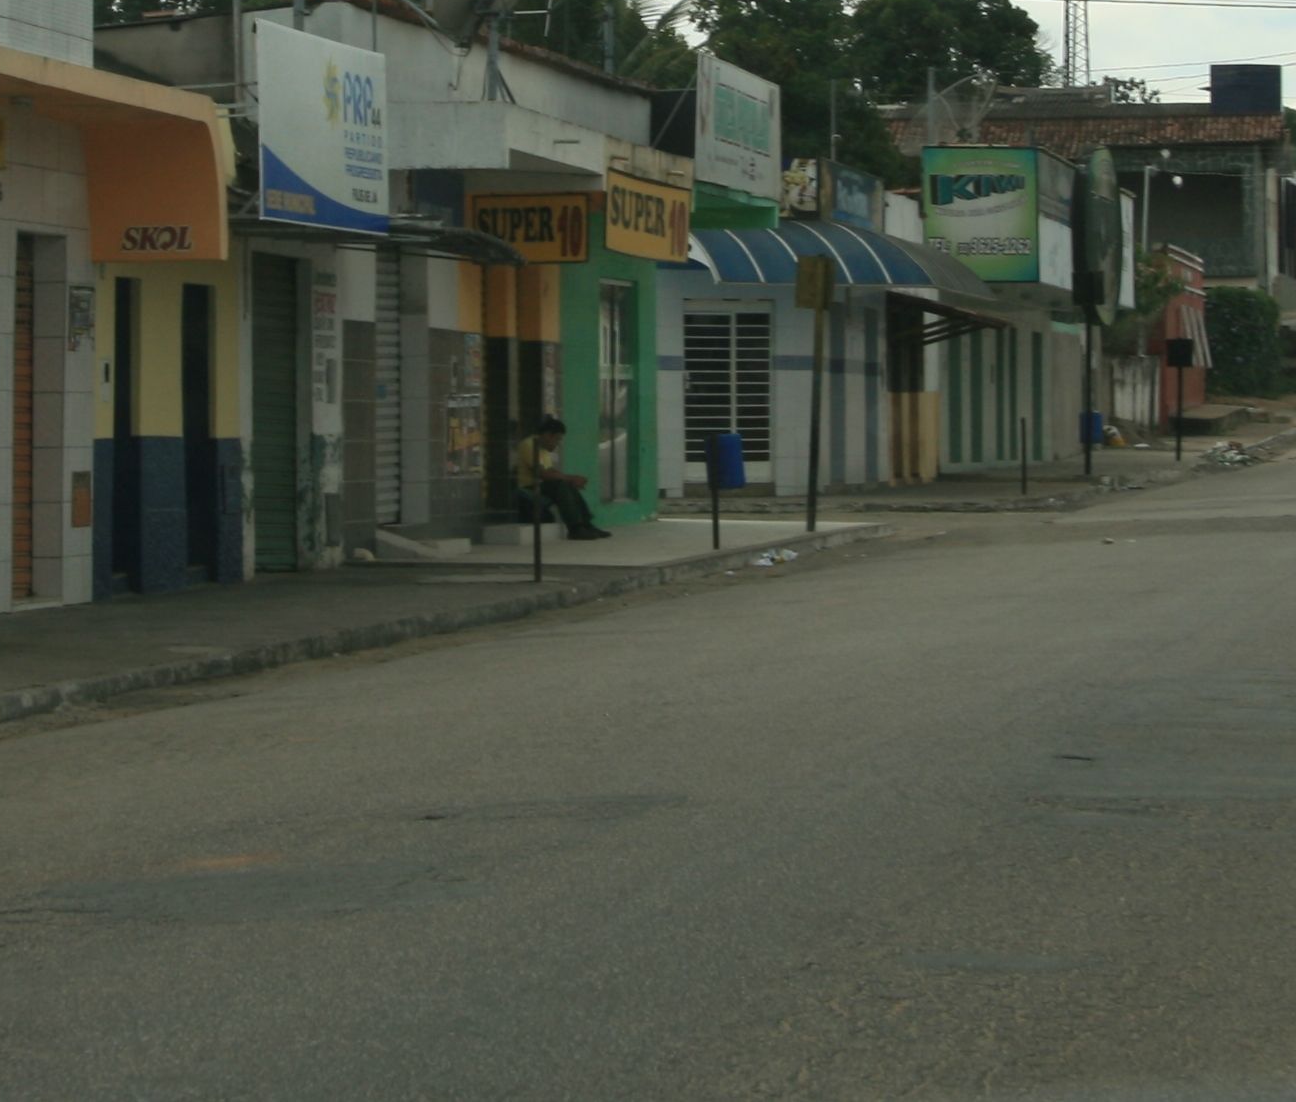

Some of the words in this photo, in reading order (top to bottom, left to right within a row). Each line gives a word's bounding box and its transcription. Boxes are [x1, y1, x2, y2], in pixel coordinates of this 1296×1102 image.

[343, 71, 373, 127] PRP
[120, 225, 193, 254] SKOL
[478, 206, 555, 243] SUPER
[557, 205, 584, 257] 10
[611, 185, 666, 238] SUPER
[669, 200, 690, 257] 10
